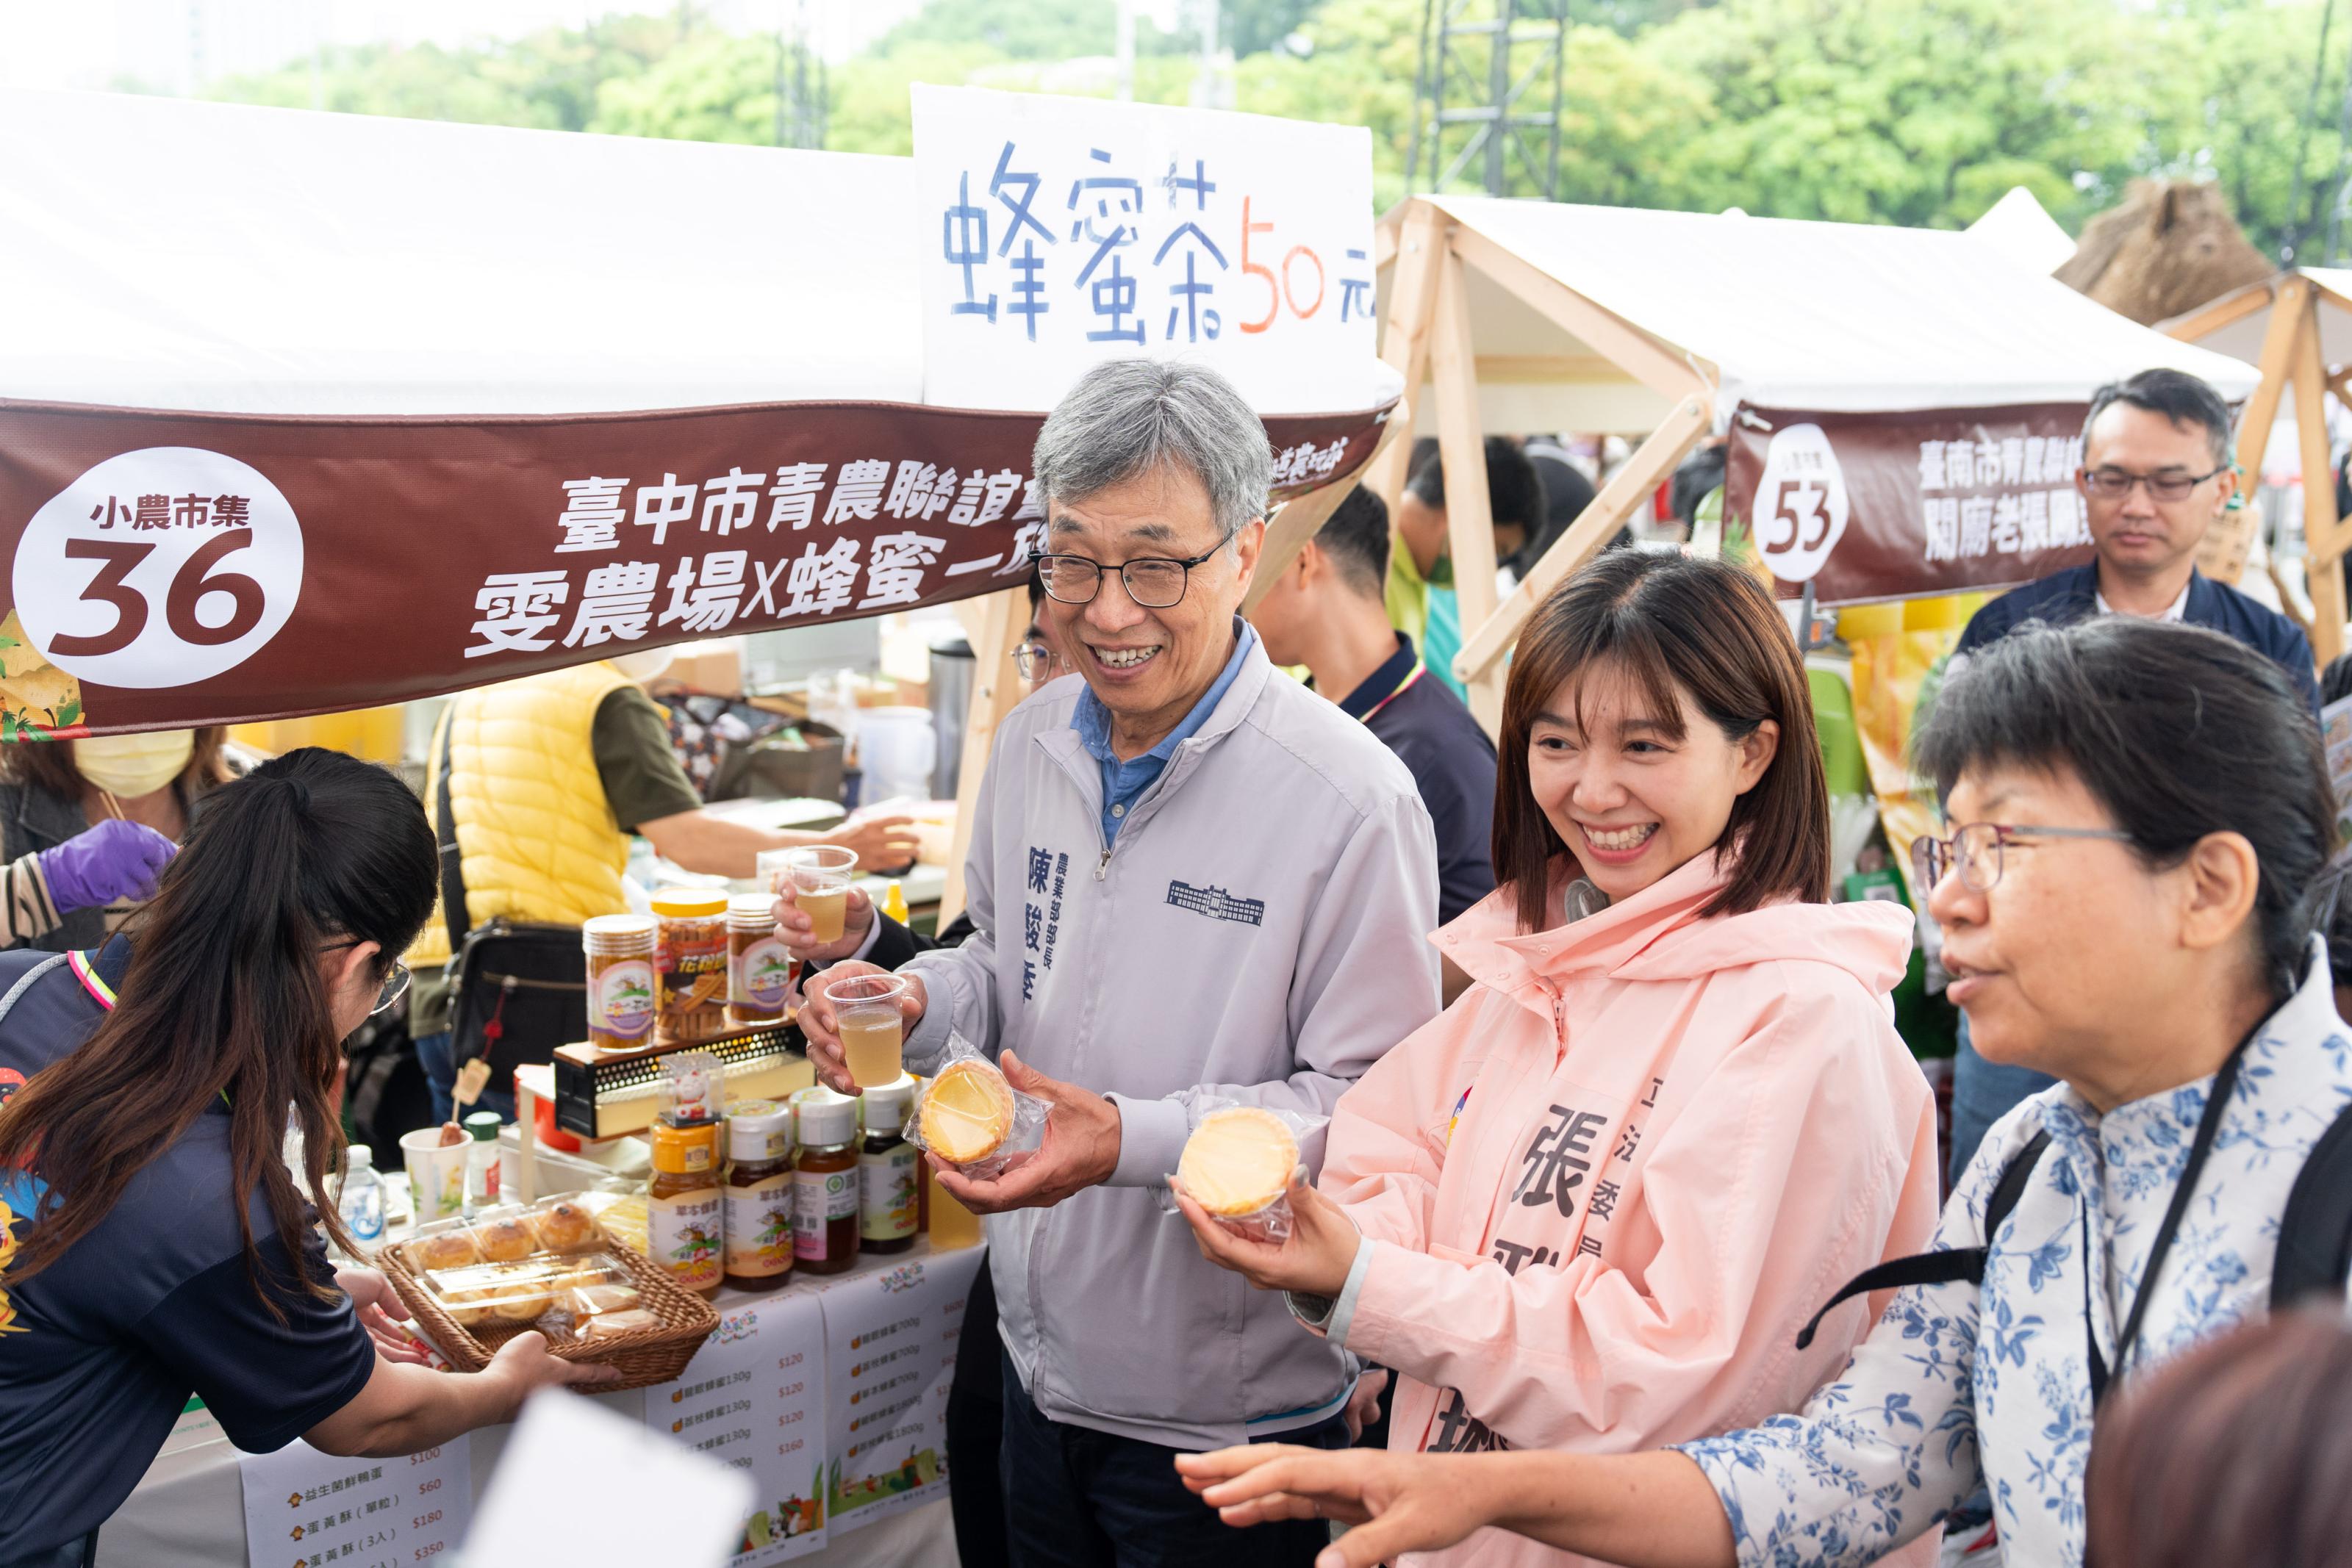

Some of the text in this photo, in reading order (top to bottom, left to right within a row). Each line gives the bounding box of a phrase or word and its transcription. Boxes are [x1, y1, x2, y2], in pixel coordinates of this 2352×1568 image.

[90, 493, 251, 531] 小農市集
[1765, 480, 1832, 555] 53
[47, 528, 265, 657] 36
[778, 1353, 803, 1369] $120
[778, 1381, 803, 1398] $120
[686, 1410, 803, 1452] 本蜂蜜130g $120
[778, 1439, 803, 1455] $160
[304, 1447, 441, 1502] 益生菌鮮鴨蛋 $100
[419, 1478, 441, 1495] $60
[412, 1509, 442, 1529] $180
[415, 1541, 444, 1561] $350
